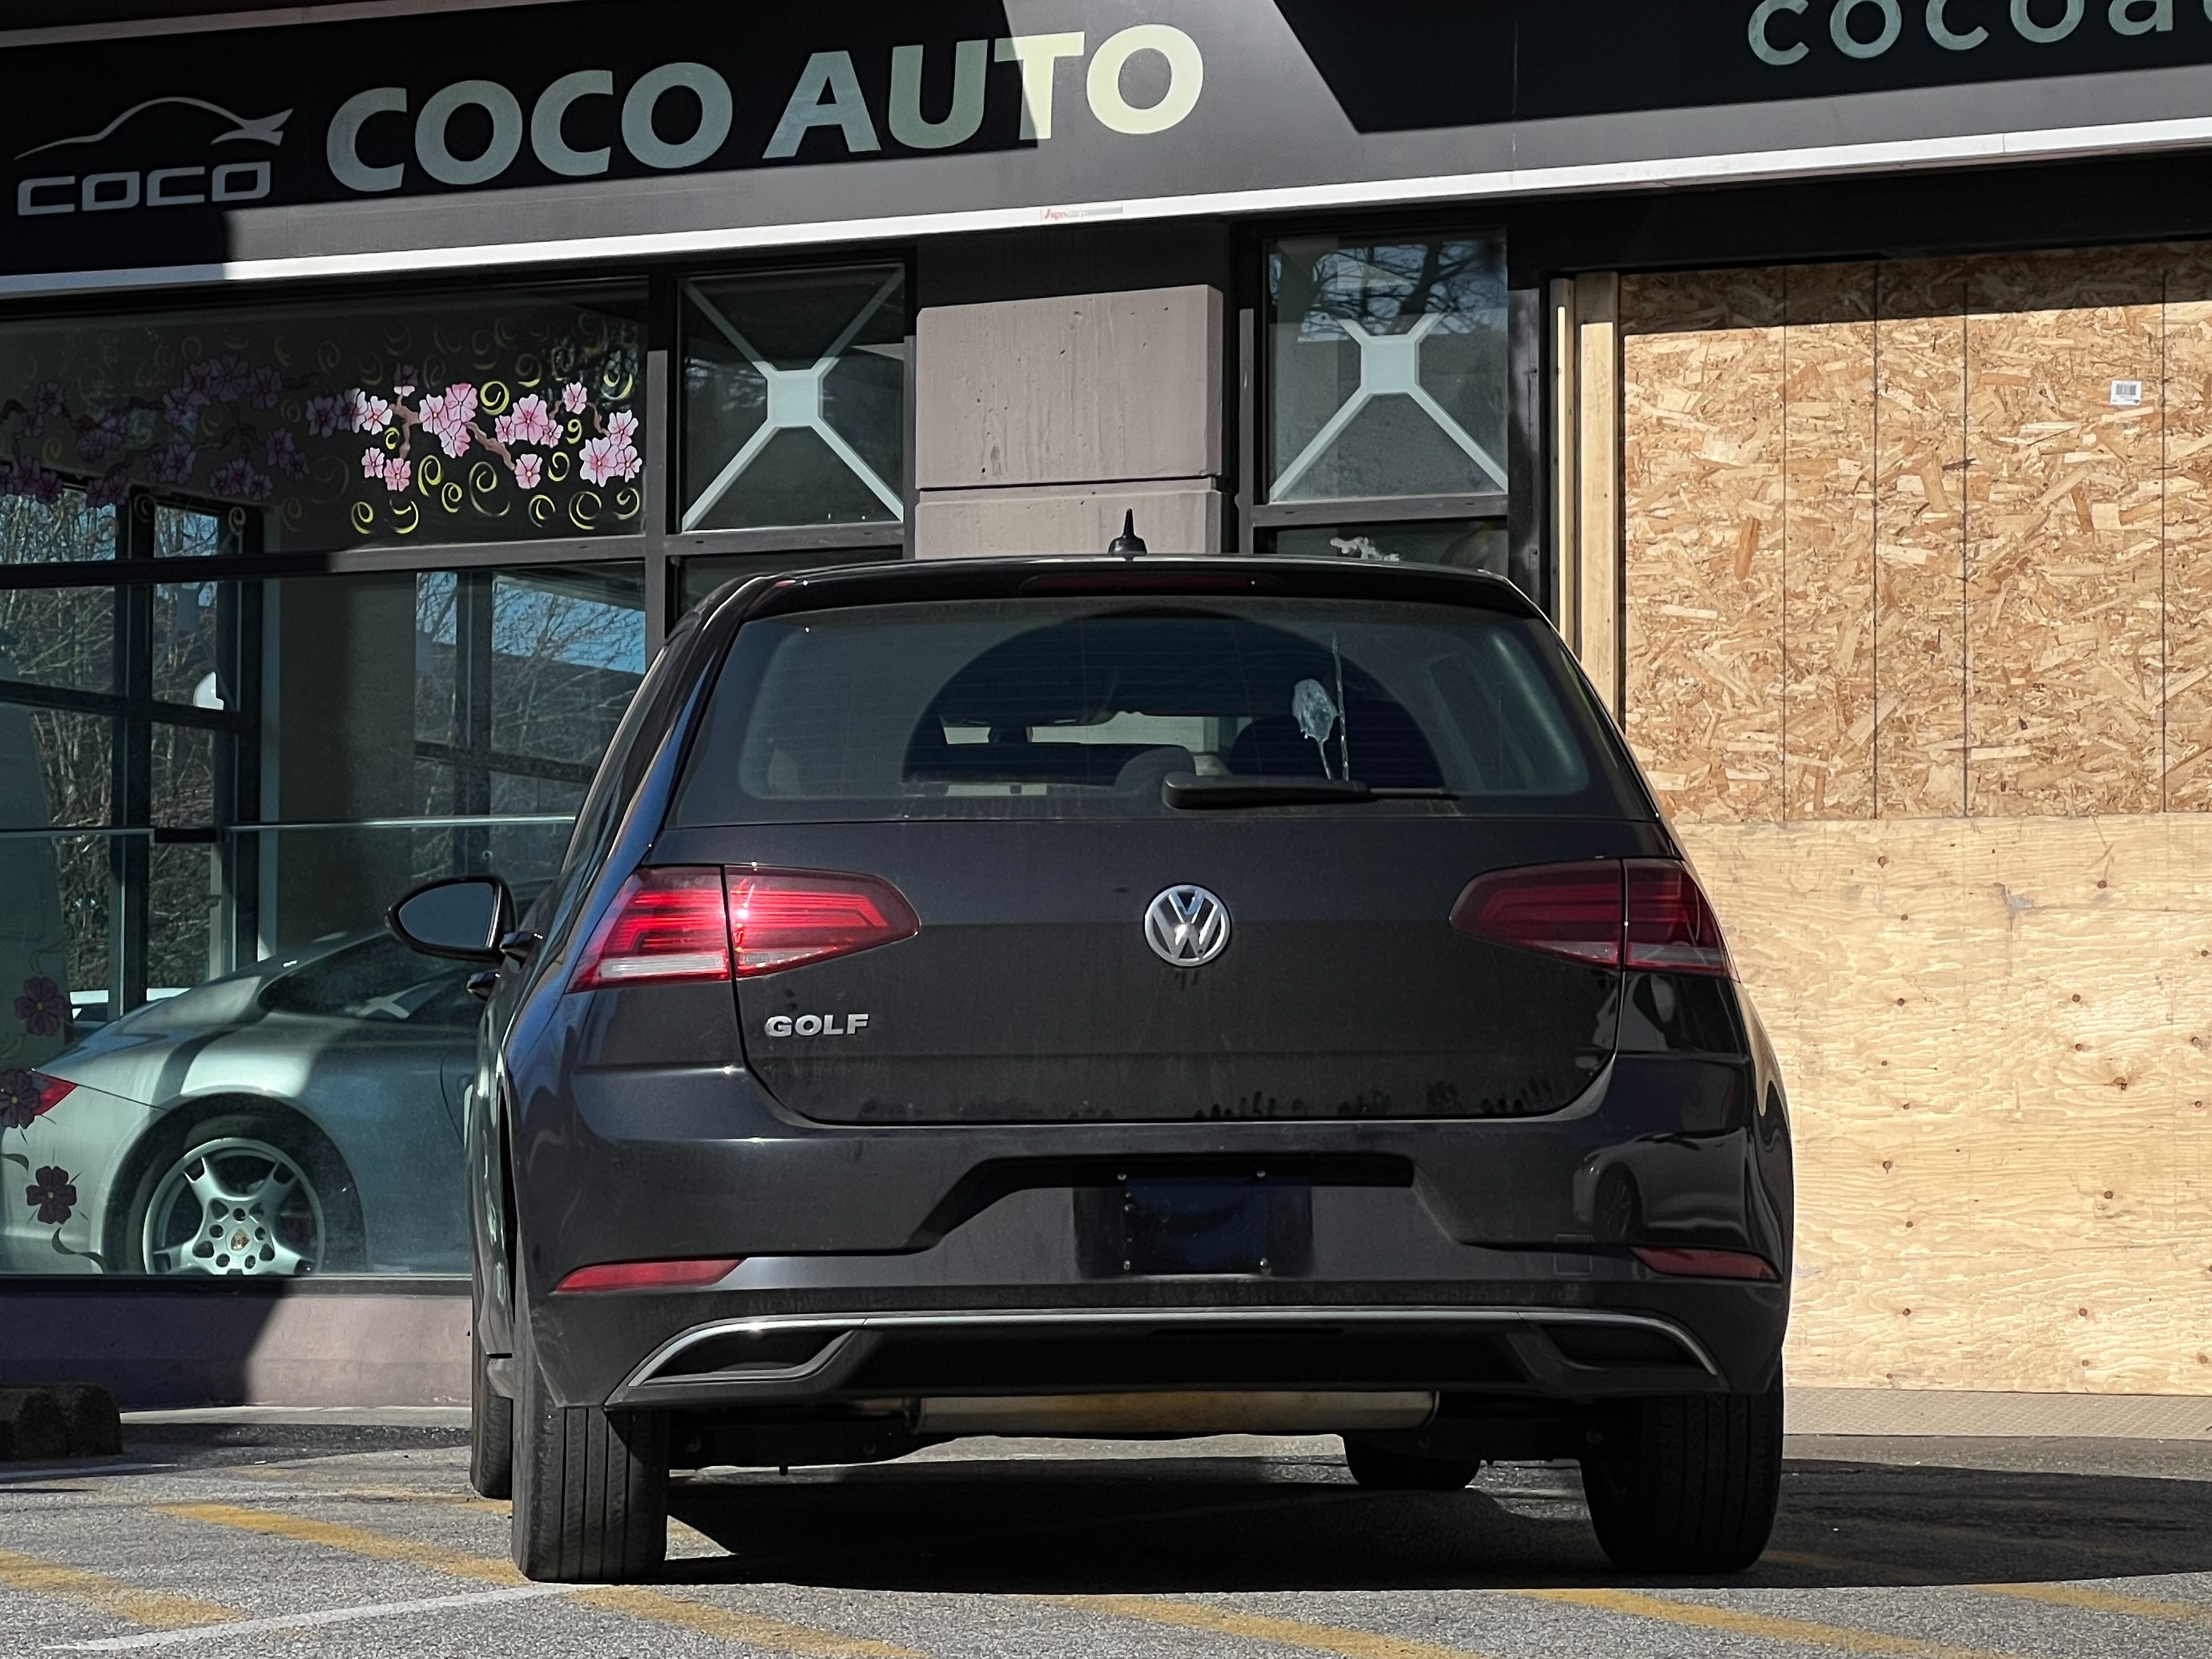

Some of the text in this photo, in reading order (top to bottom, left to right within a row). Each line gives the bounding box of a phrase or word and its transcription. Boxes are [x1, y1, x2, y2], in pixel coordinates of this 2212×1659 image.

[1748, 0, 2212, 65] cocoa
[327, 25, 1203, 191] COCO AUTO
[764, 1013, 869, 1037] GOLF
